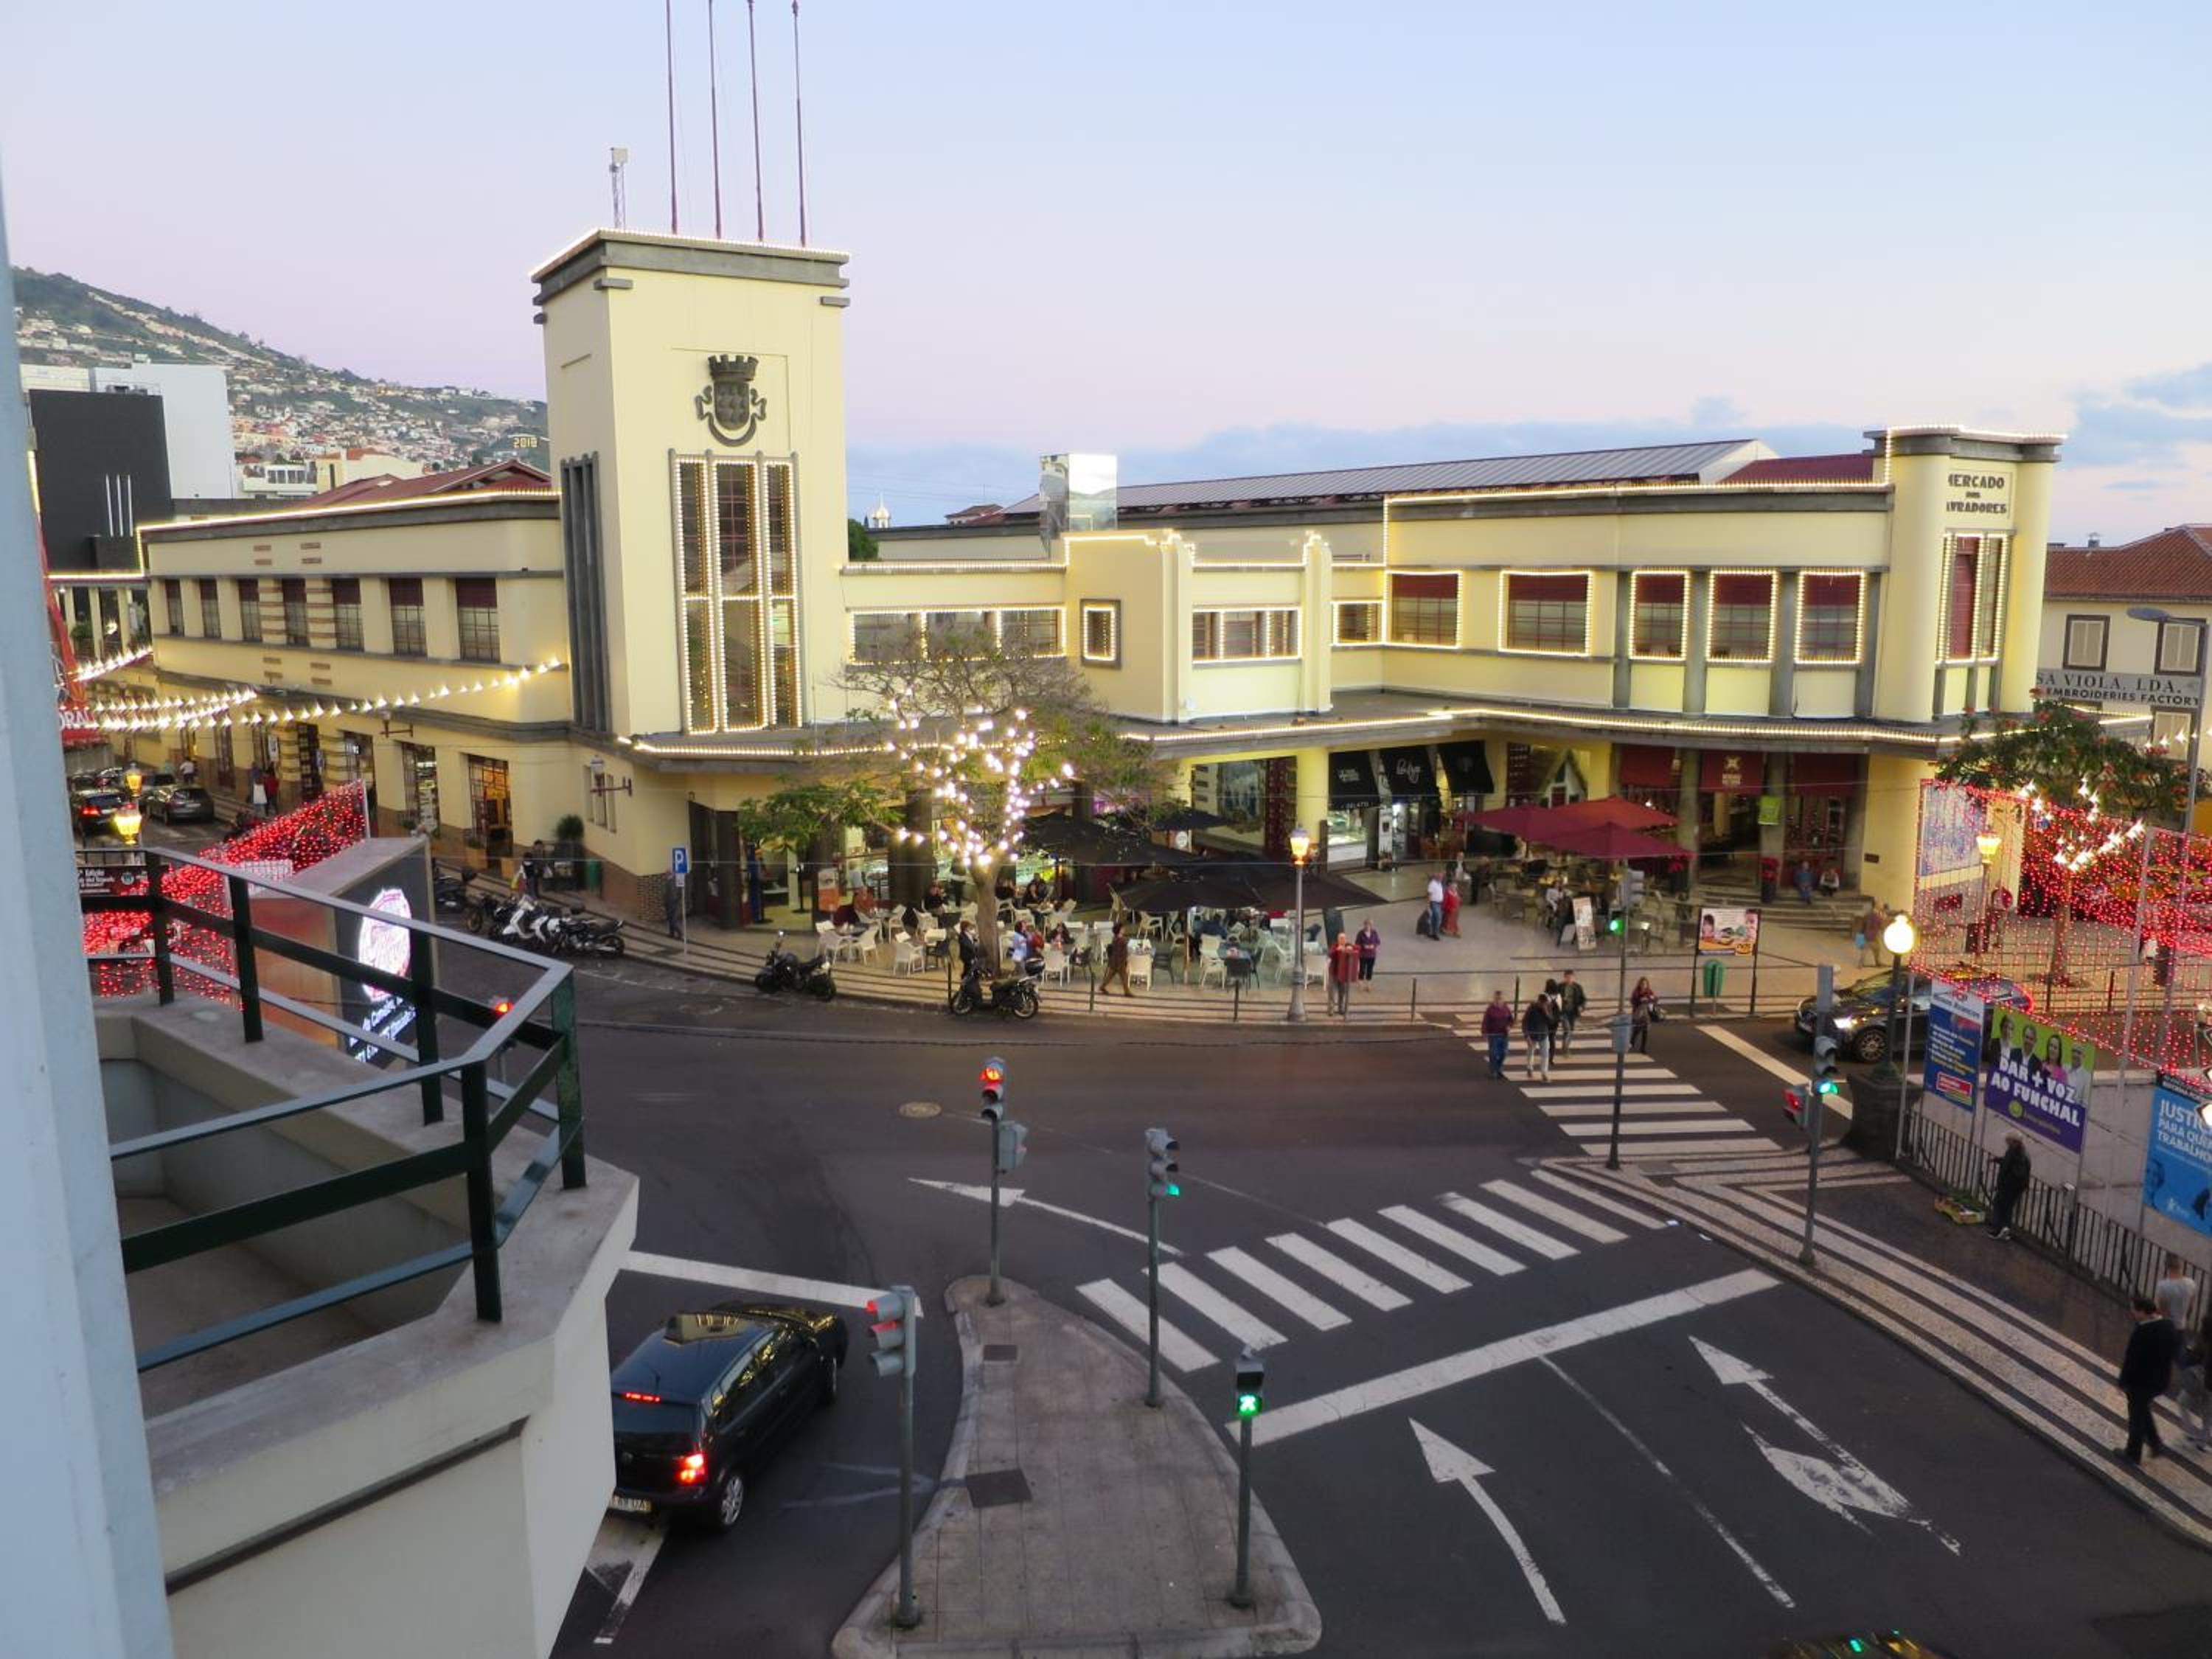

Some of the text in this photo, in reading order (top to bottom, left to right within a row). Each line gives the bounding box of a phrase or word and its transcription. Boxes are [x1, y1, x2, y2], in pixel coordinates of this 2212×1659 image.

[2047, 687, 2136, 702] EMBROIDERIES
[2135, 678, 2182, 694] LDA.
[675, 849, 684, 872] P
[1999, 1055, 2028, 1082] DAR
[2047, 1077, 2076, 1104] VOZ
[1992, 1071, 2010, 1092] AO
[2014, 1082, 2080, 1127] FUNCHAL
